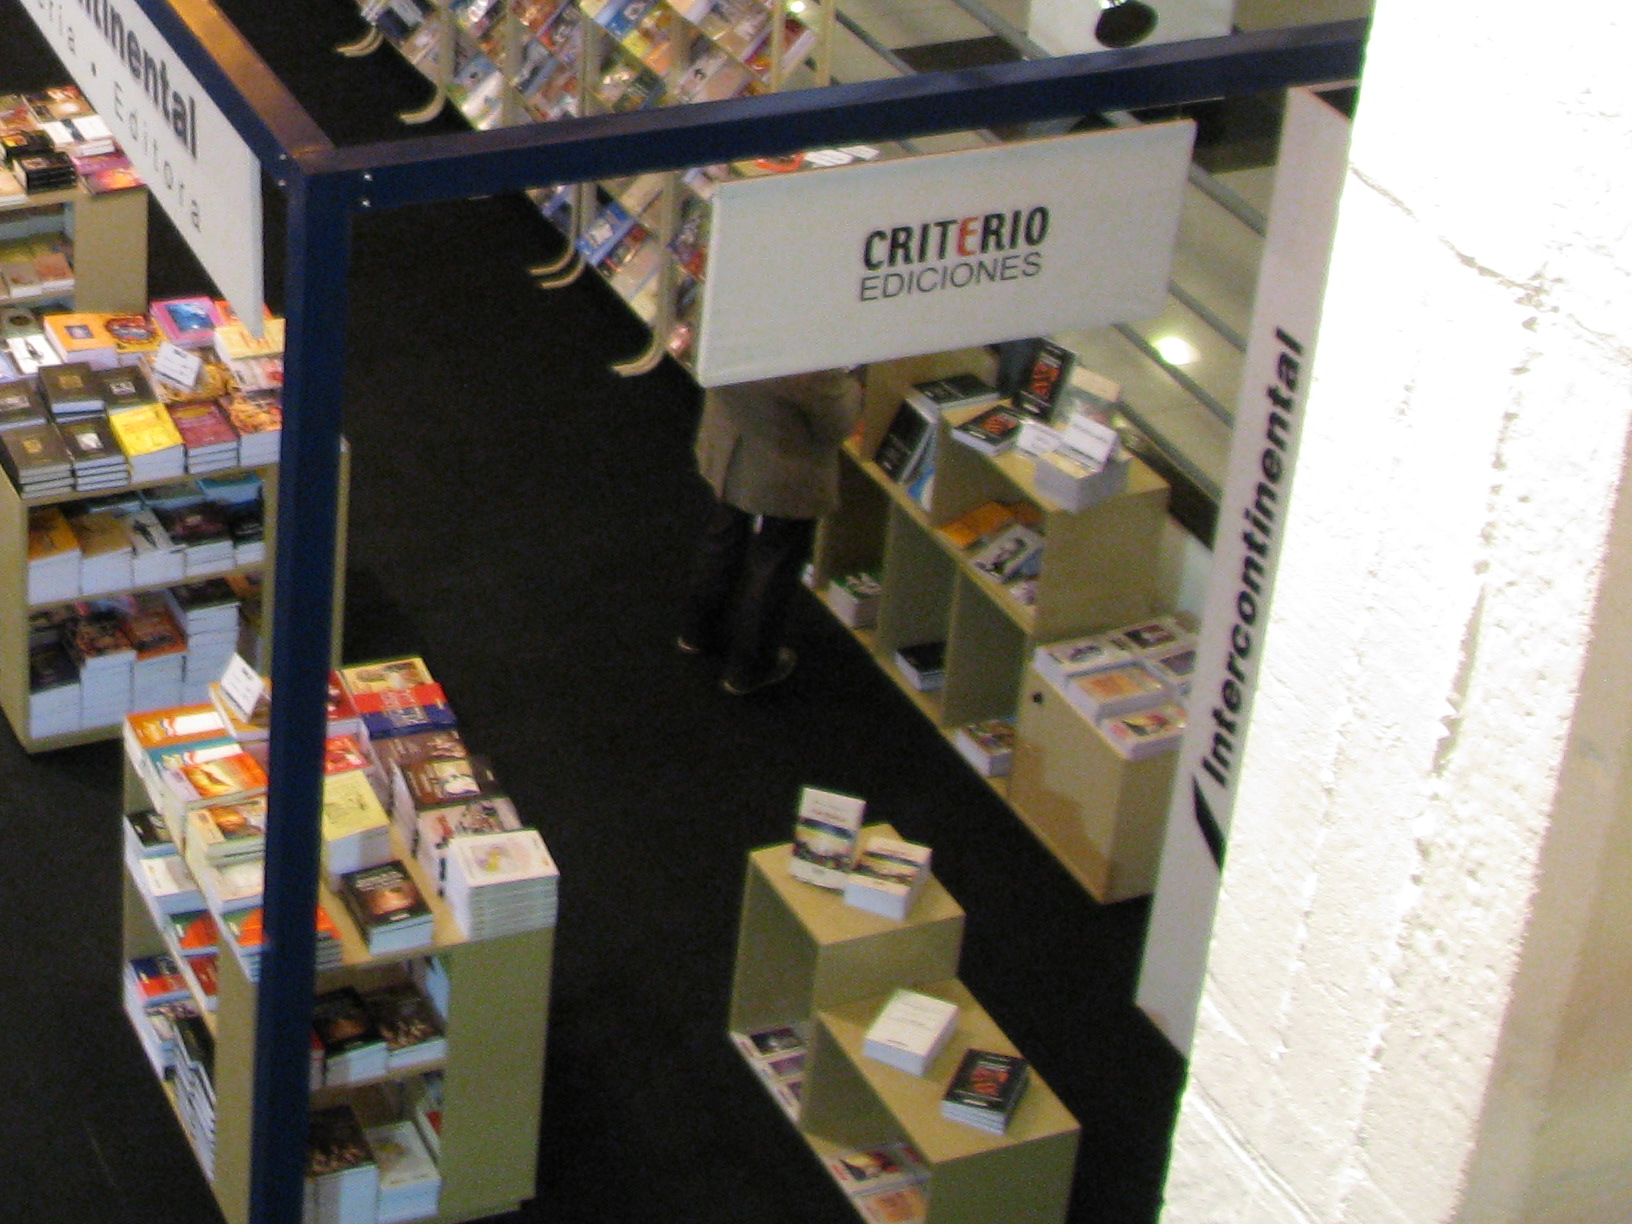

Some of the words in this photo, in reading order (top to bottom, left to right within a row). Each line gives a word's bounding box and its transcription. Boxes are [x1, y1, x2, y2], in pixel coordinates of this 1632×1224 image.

[113, 80, 202, 235] Editora
[860, 251, 1043, 302] EDICIONES
[863, 206, 1050, 271] CRITERIO
[1200, 327, 1304, 790] Intercontinental
